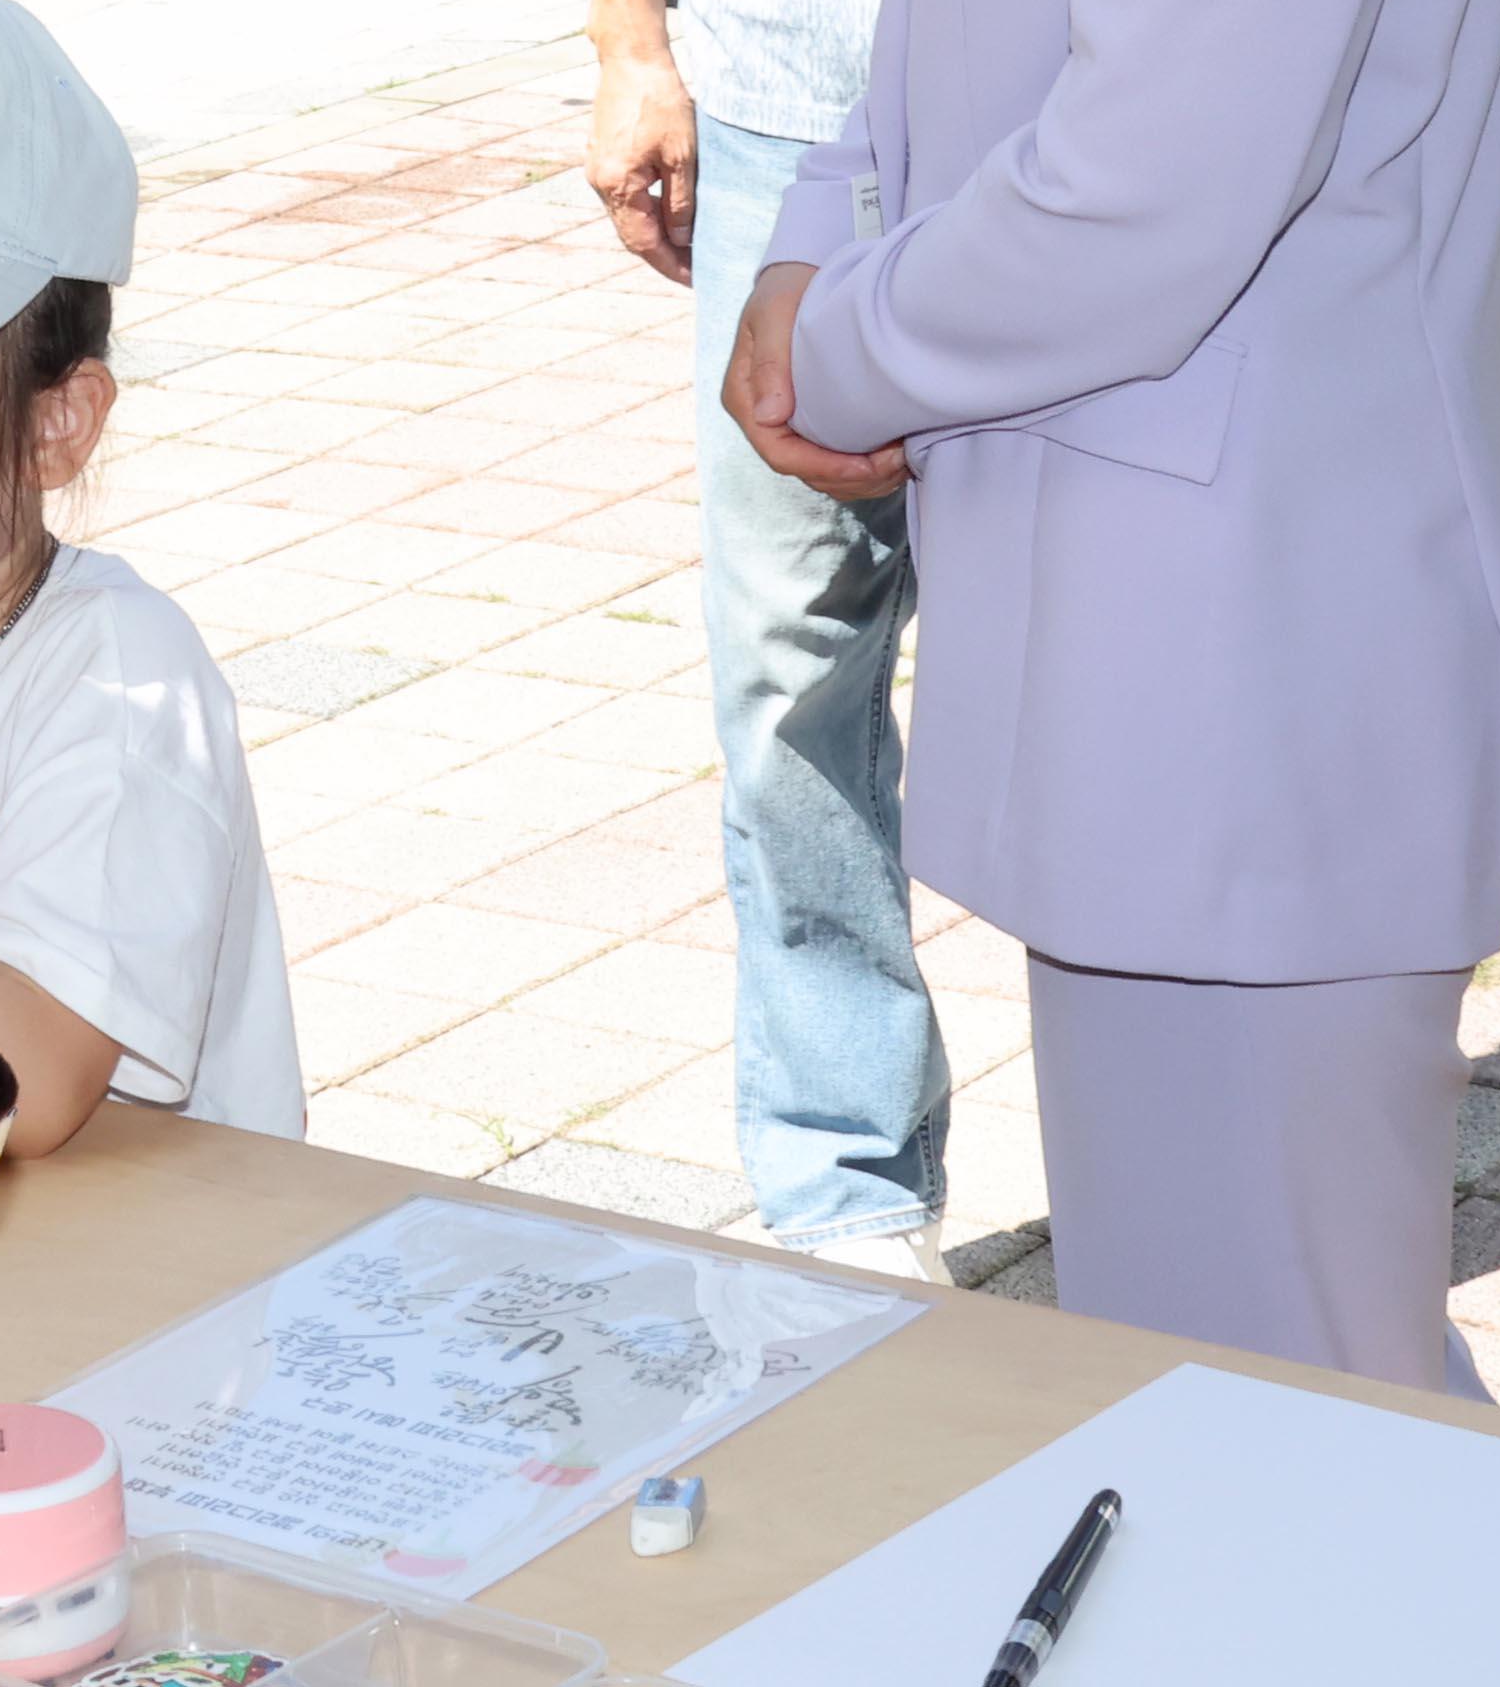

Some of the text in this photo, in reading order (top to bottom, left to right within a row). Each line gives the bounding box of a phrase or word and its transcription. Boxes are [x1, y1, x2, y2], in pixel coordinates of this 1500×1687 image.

[300, 1396, 535, 1456] 캘리그라피 예시 문구
[175, 1491, 303, 1530] 캘리그라피
[303, 1523, 387, 1552] 나만의
